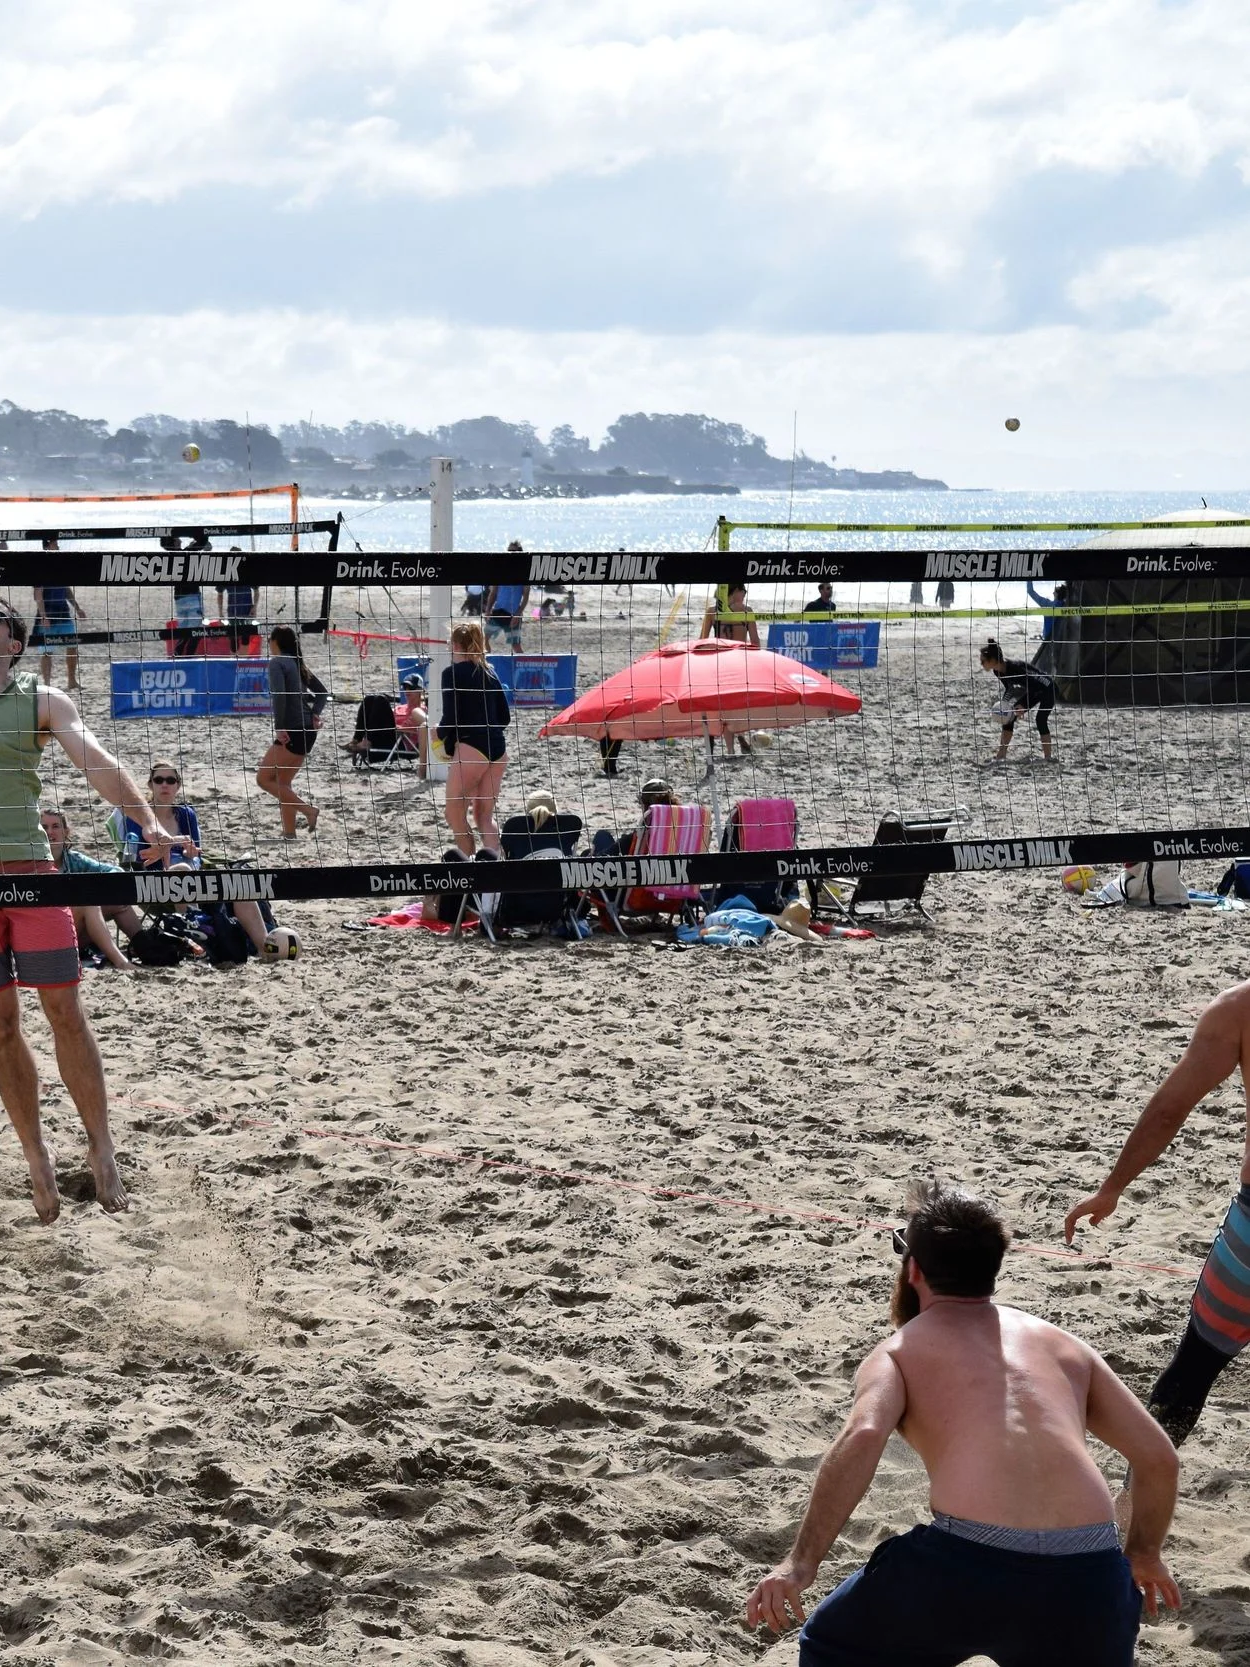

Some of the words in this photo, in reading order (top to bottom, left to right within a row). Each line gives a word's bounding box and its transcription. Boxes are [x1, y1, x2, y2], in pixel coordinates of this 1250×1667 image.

[8, 531, 26, 540] MILK
[125, 528, 153, 537] MUSCLE
[154, 528, 172, 536] MILK
[100, 555, 185, 582] MUSCLE
[187, 555, 241, 581] MILK
[337, 560, 387, 577] Drink.
[529, 555, 607, 581] MUSCLE
[609, 555, 660, 580] MILK
[747, 559, 794, 575] Drink.
[925, 553, 997, 578] MUSCLE
[999, 553, 1046, 577] MILK
[1127, 555, 1170, 571] Drink.
[784, 631, 809, 647] BUD
[140, 669, 187, 689] BUD
[132, 688, 196, 709] LIGHT
[953, 843, 1025, 870] MUSCLE
[1026, 840, 1070, 866] MILK
[1154, 838, 1200, 855] Drink.
[560, 861, 637, 888] MUSCLE
[640, 859, 688, 885] MILK
[777, 858, 826, 875] Drink.
[135, 876, 218, 903] MUSCLE
[221, 873, 274, 900] MILK
[370, 873, 421, 891] Drink.
